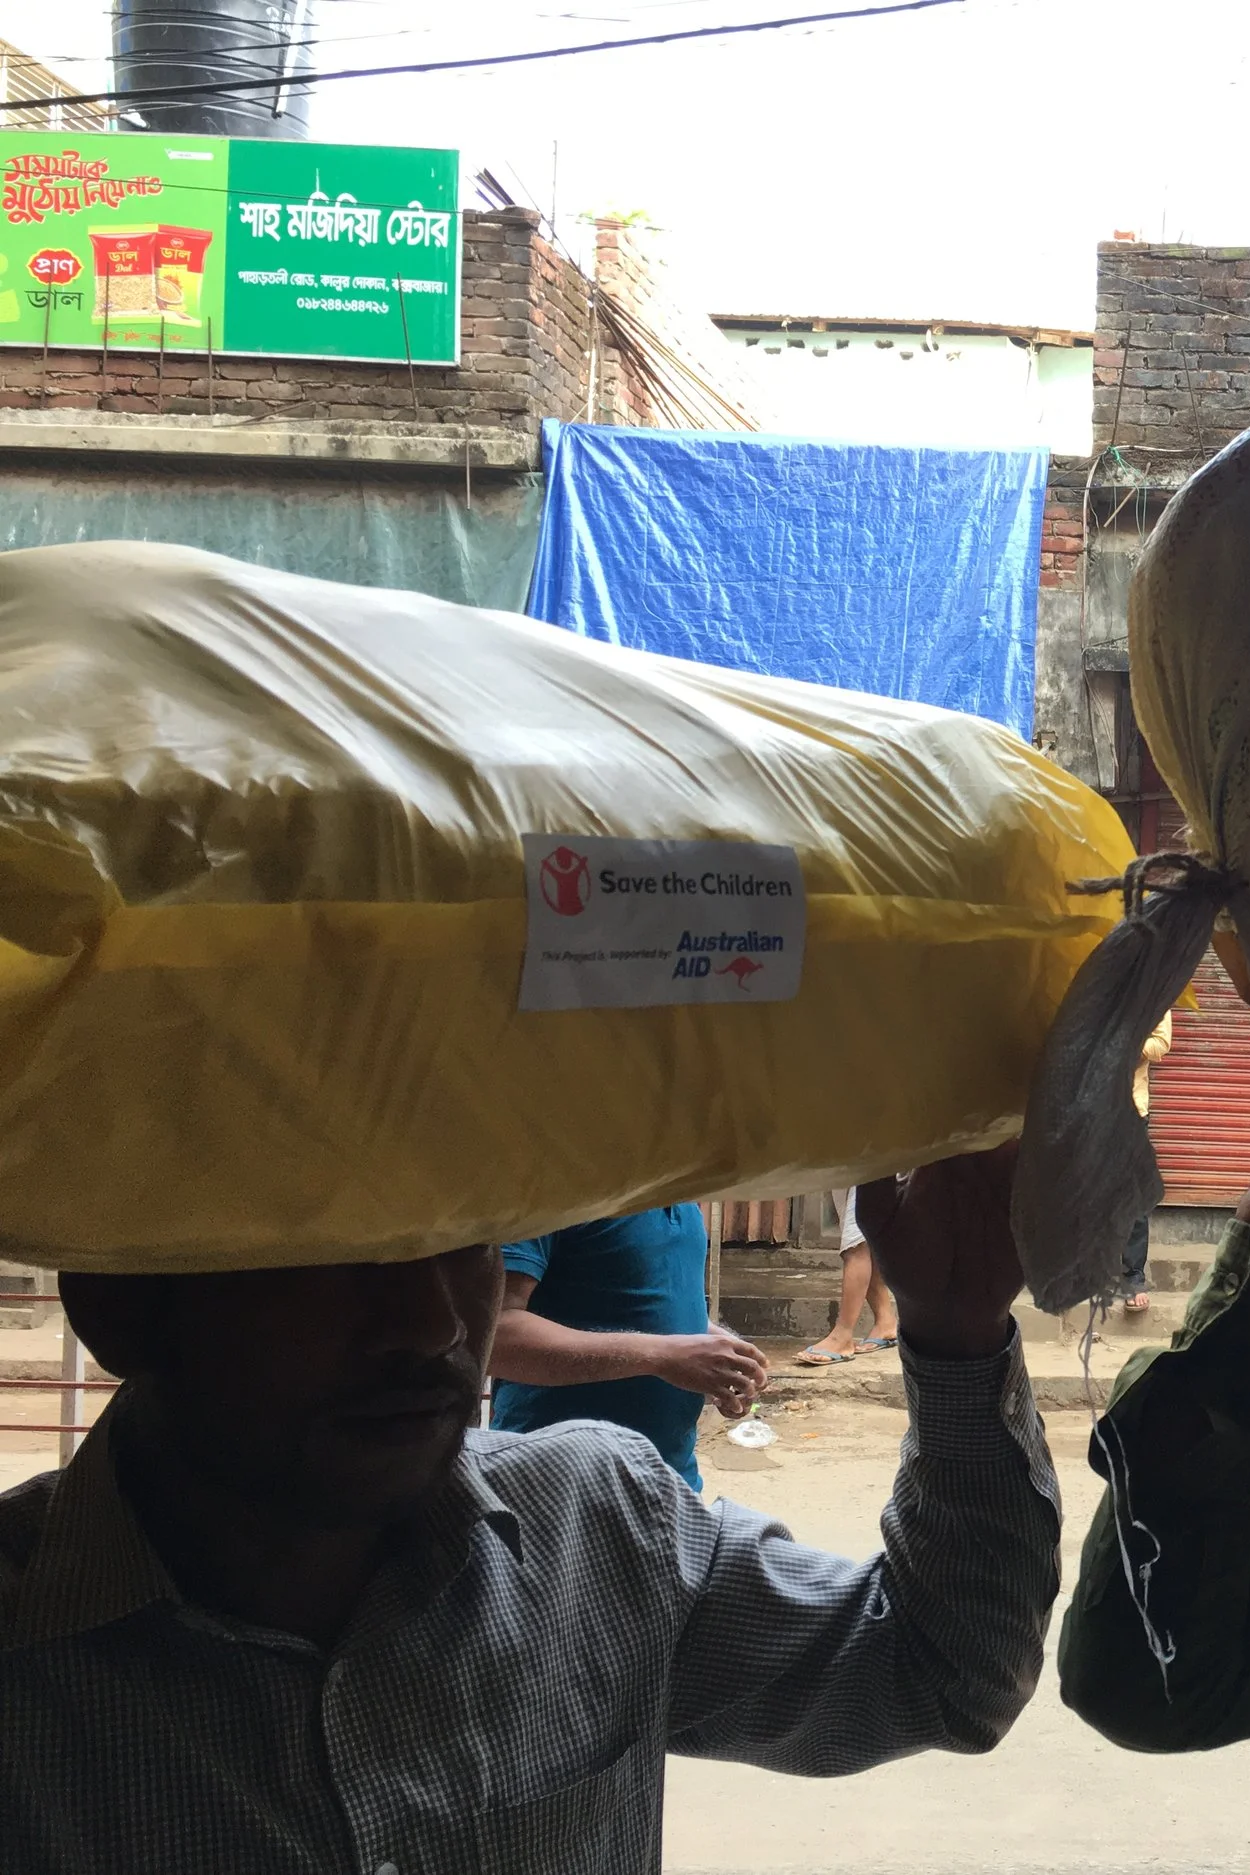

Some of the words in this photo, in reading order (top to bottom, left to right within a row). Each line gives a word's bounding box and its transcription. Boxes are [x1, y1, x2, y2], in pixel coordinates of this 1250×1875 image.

[82, 179, 125, 208] নিয়ে
[127, 176, 163, 196] নাও
[239, 202, 282, 242] শাহ
[286, 191, 381, 247] মজিদিয়া
[386, 200, 451, 248] স্টোর
[34, 256, 74, 276] প্রাণ
[107, 251, 139, 262] ডাল
[290, 273, 318, 288] রোড,
[25, 289, 84, 311] ডাল
[599, 870, 657, 895] Save
[662, 871, 697, 895] the
[701, 872, 793, 897] Children
[676, 931, 784, 953] Australian
[672, 956, 711, 980] AID
